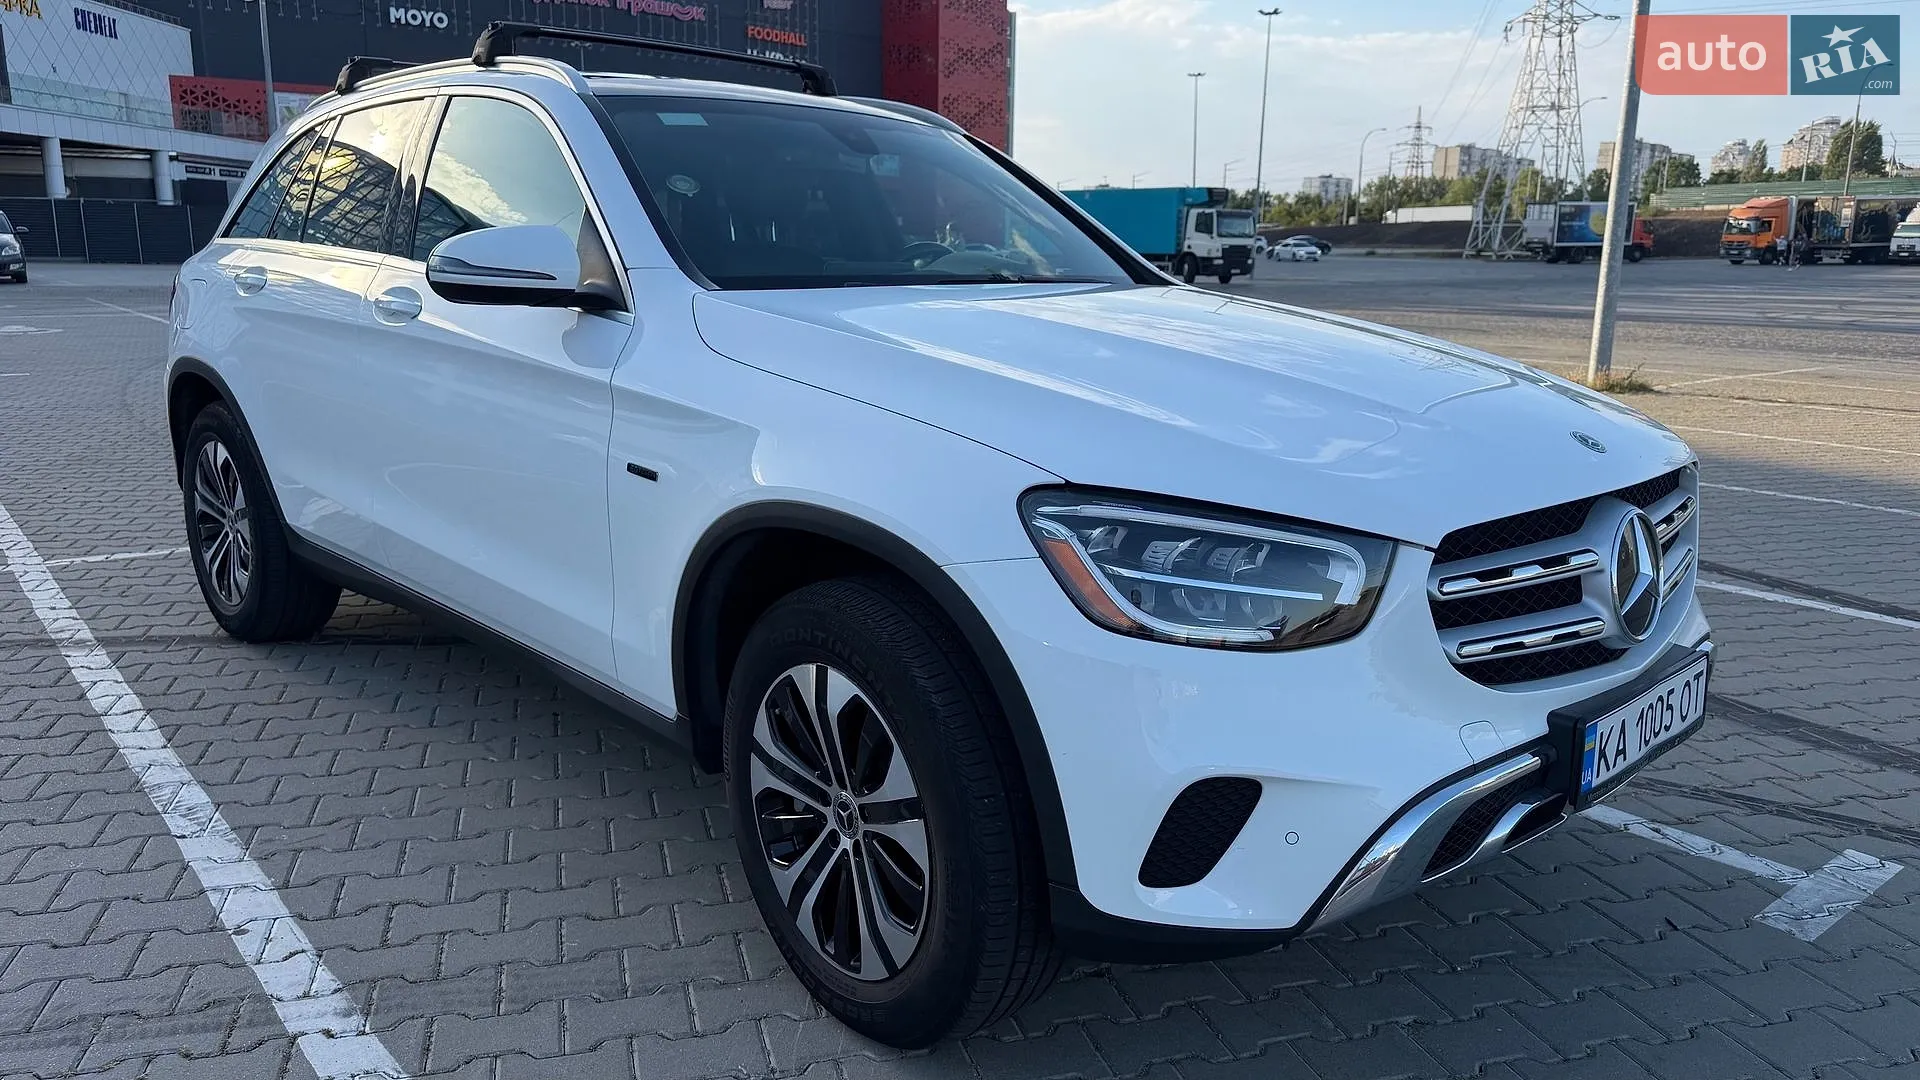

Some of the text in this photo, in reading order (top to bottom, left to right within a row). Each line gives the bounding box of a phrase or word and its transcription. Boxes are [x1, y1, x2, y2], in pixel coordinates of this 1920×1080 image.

[389, 6, 449, 29] MOYO
[747, 26, 807, 47] FOODHALL
[1596, 669, 1704, 779] KA 1005 OT
[1581, 769, 1592, 784] UA
